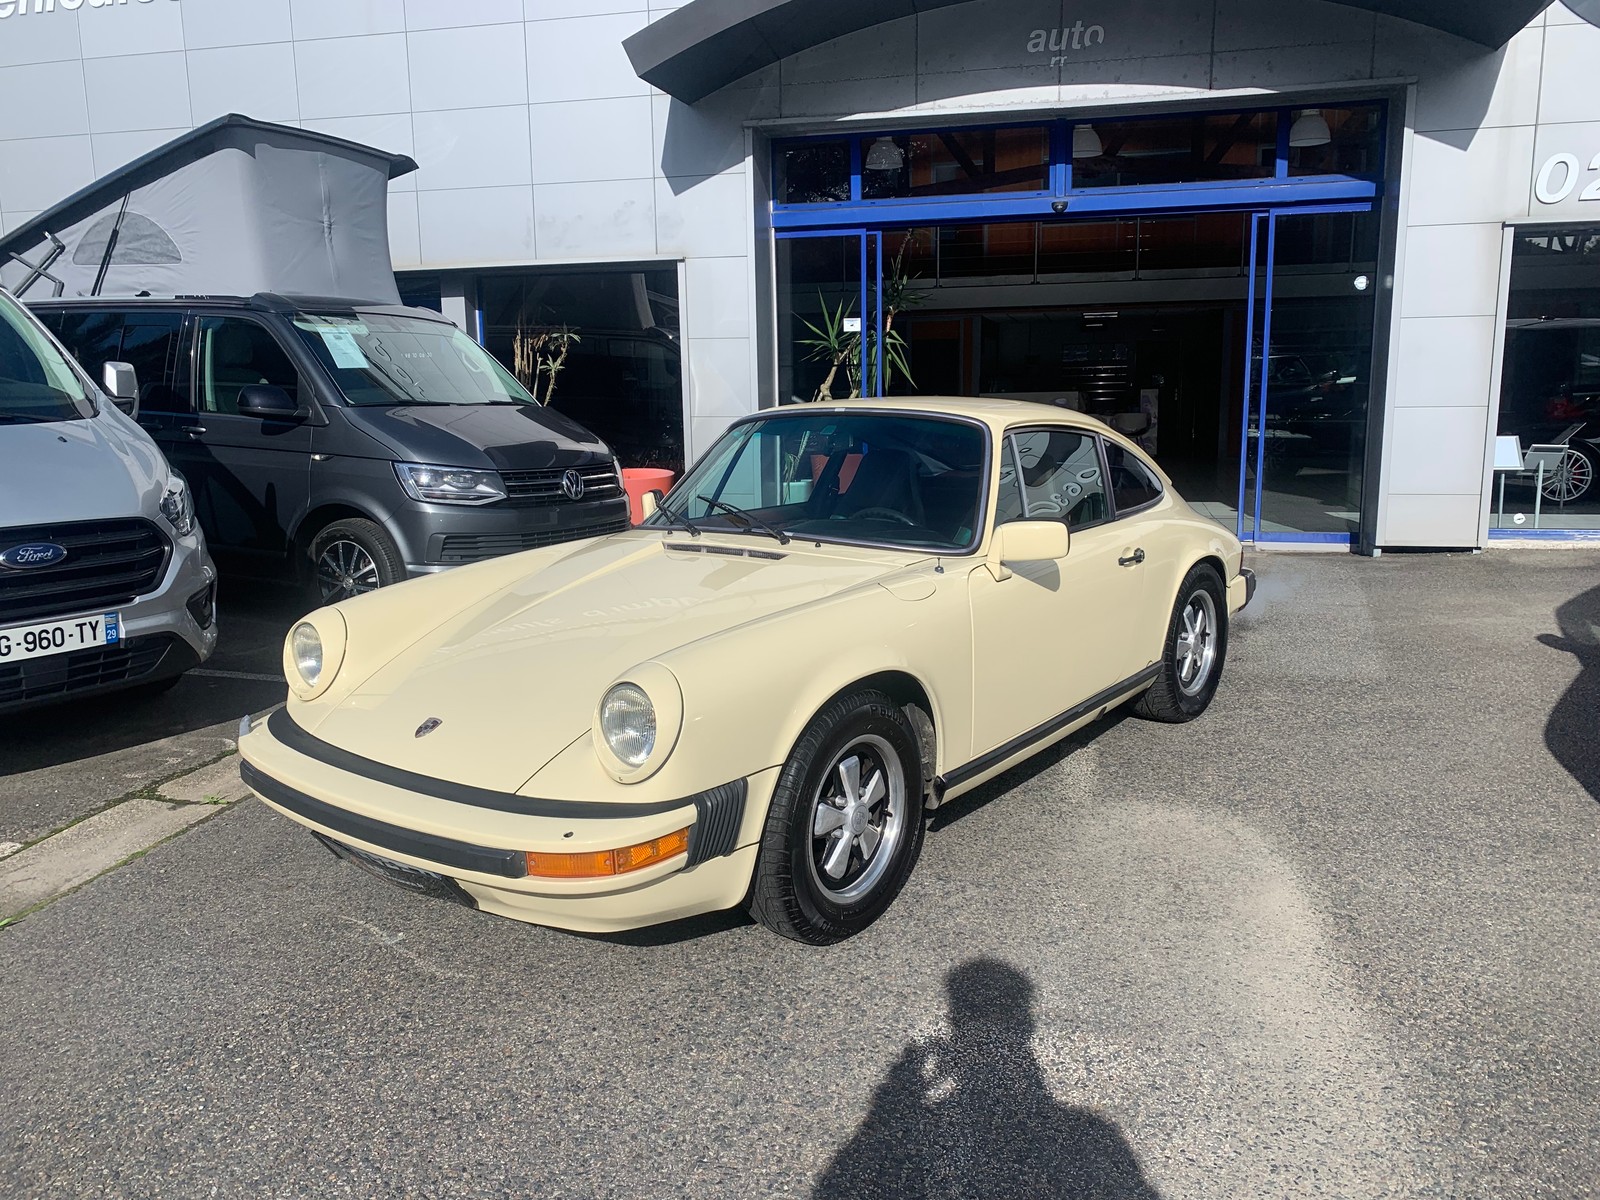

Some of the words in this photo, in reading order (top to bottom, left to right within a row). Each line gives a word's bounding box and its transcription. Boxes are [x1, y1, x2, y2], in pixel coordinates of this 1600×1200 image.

[1027, 20, 1105, 53] auto
[16, 546, 54, 563] Ford
[106, 629, 117, 640] 29
